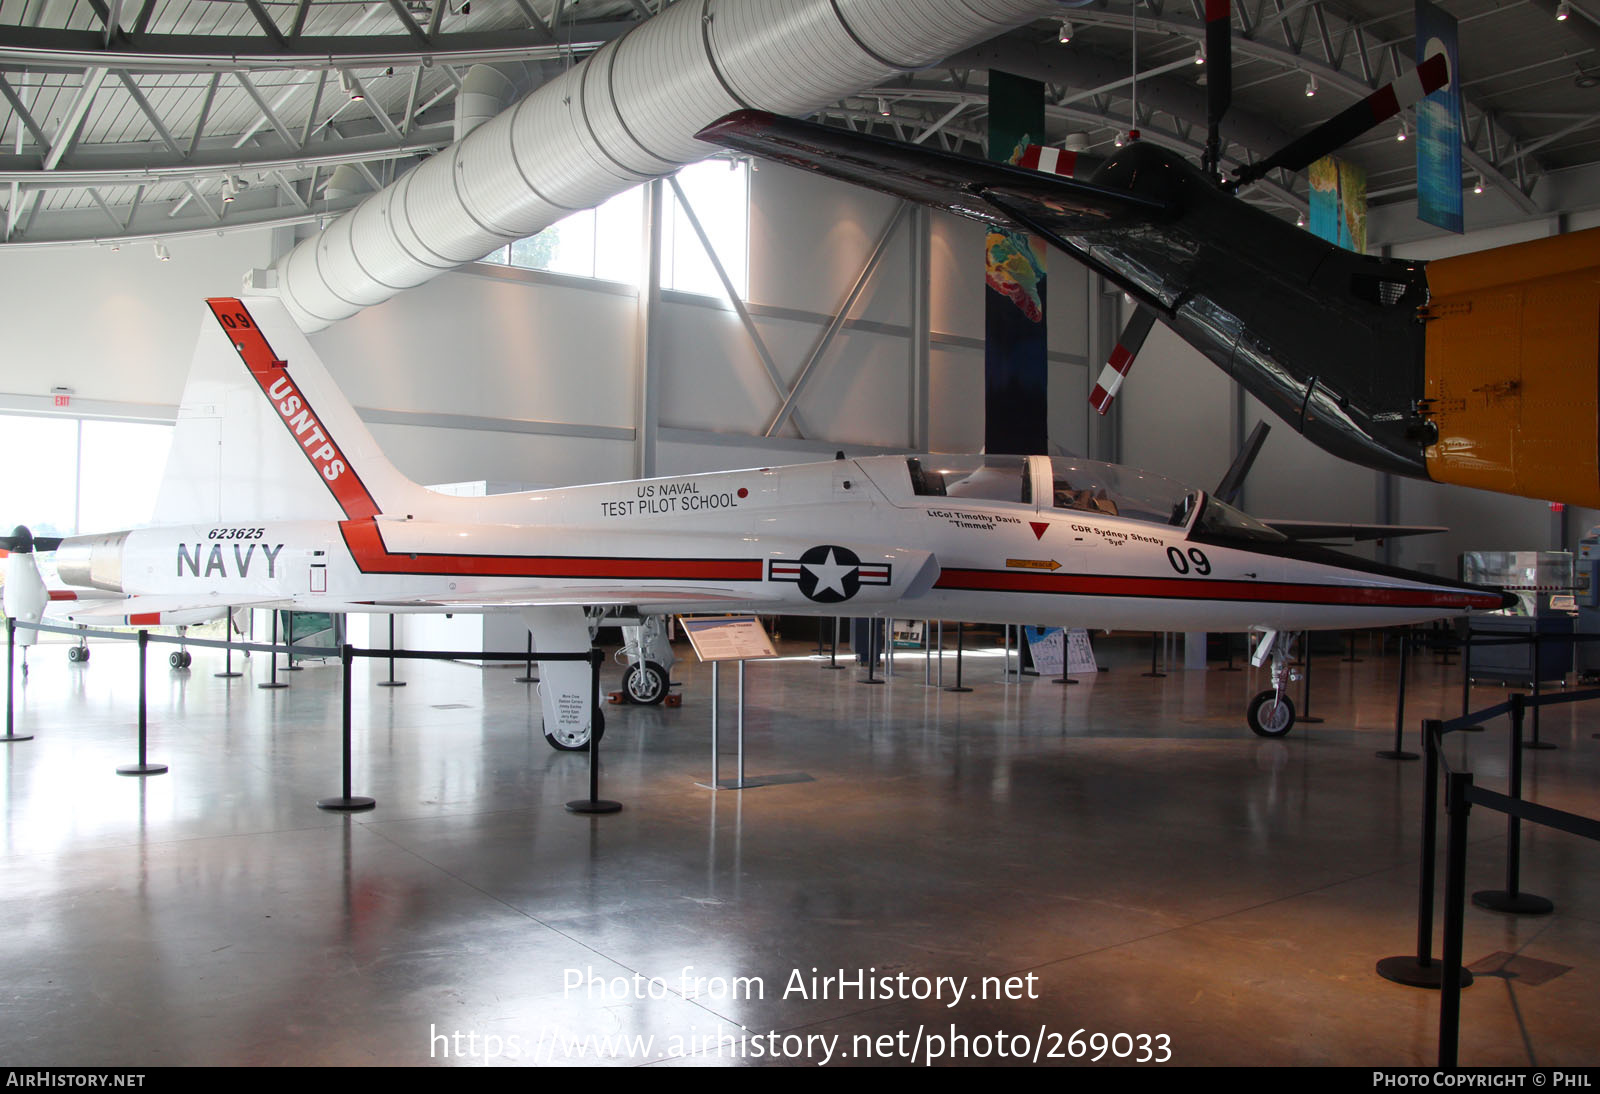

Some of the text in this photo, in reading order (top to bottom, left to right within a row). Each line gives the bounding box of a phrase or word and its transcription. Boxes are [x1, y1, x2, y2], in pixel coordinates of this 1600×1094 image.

[221, 313, 251, 329] 09
[55, 395, 70, 407] EXIT
[269, 376, 345, 481] USNTPS
[637, 482, 700, 498] US NAVAL
[601, 493, 738, 517] TEST PILOT SCHOOL
[927, 510, 1021, 524] LtCol Timothy Davis
[208, 528, 265, 540] 623625
[1071, 524, 1164, 546] CDR Sydney Sherby
[177, 543, 285, 578] NAVY
[1166, 546, 1212, 576] 09
